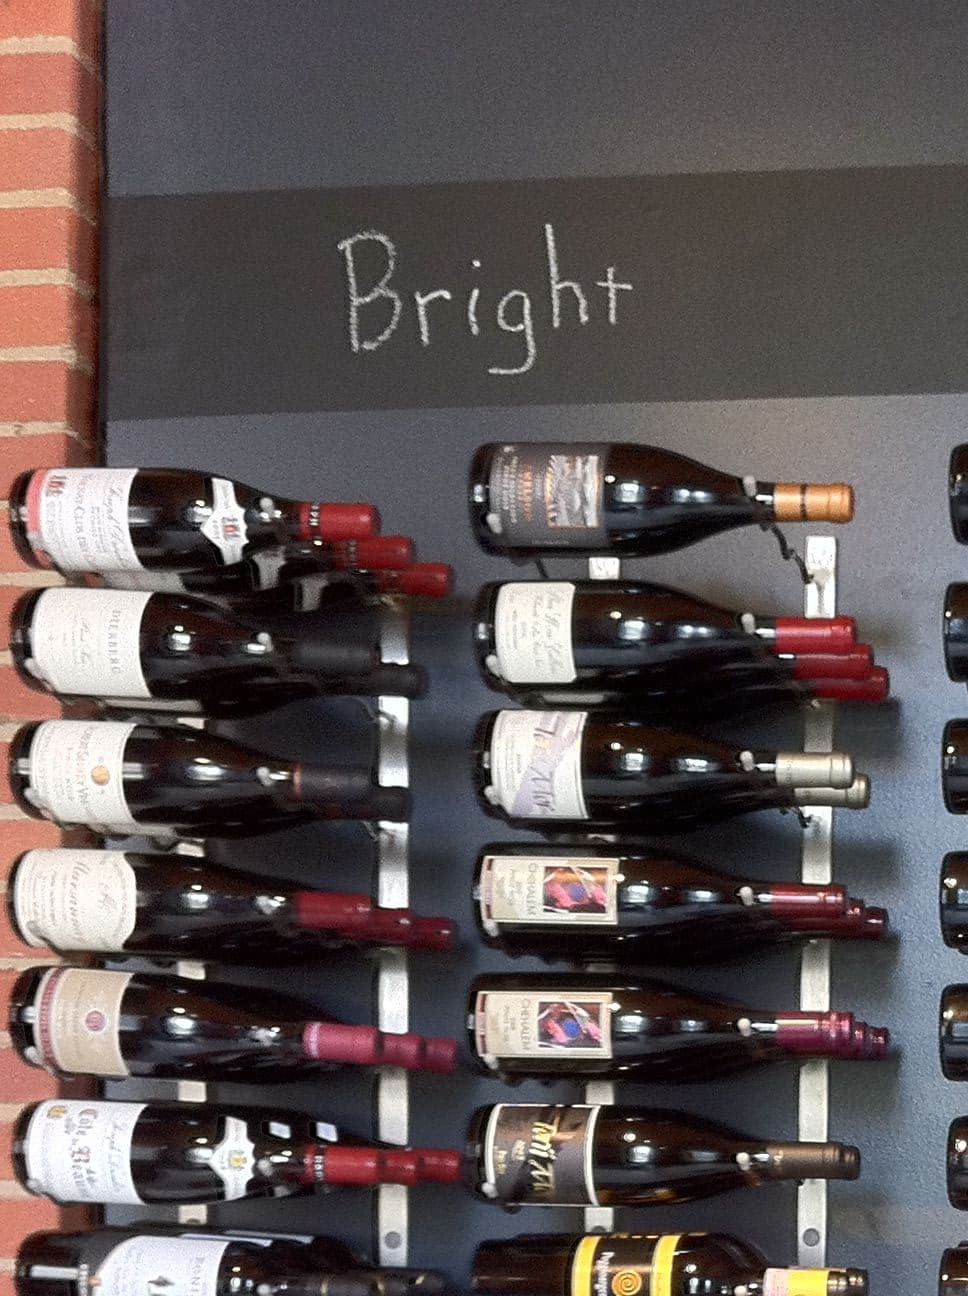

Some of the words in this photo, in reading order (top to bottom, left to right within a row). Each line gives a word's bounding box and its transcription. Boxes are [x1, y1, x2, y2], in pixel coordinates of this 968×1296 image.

[338, 223, 633, 374] Bright
[108, 610, 123, 674] DIERBERG
[526, 862, 538, 915] CHEHALEM
[520, 998, 532, 1051] CHEHALEM
